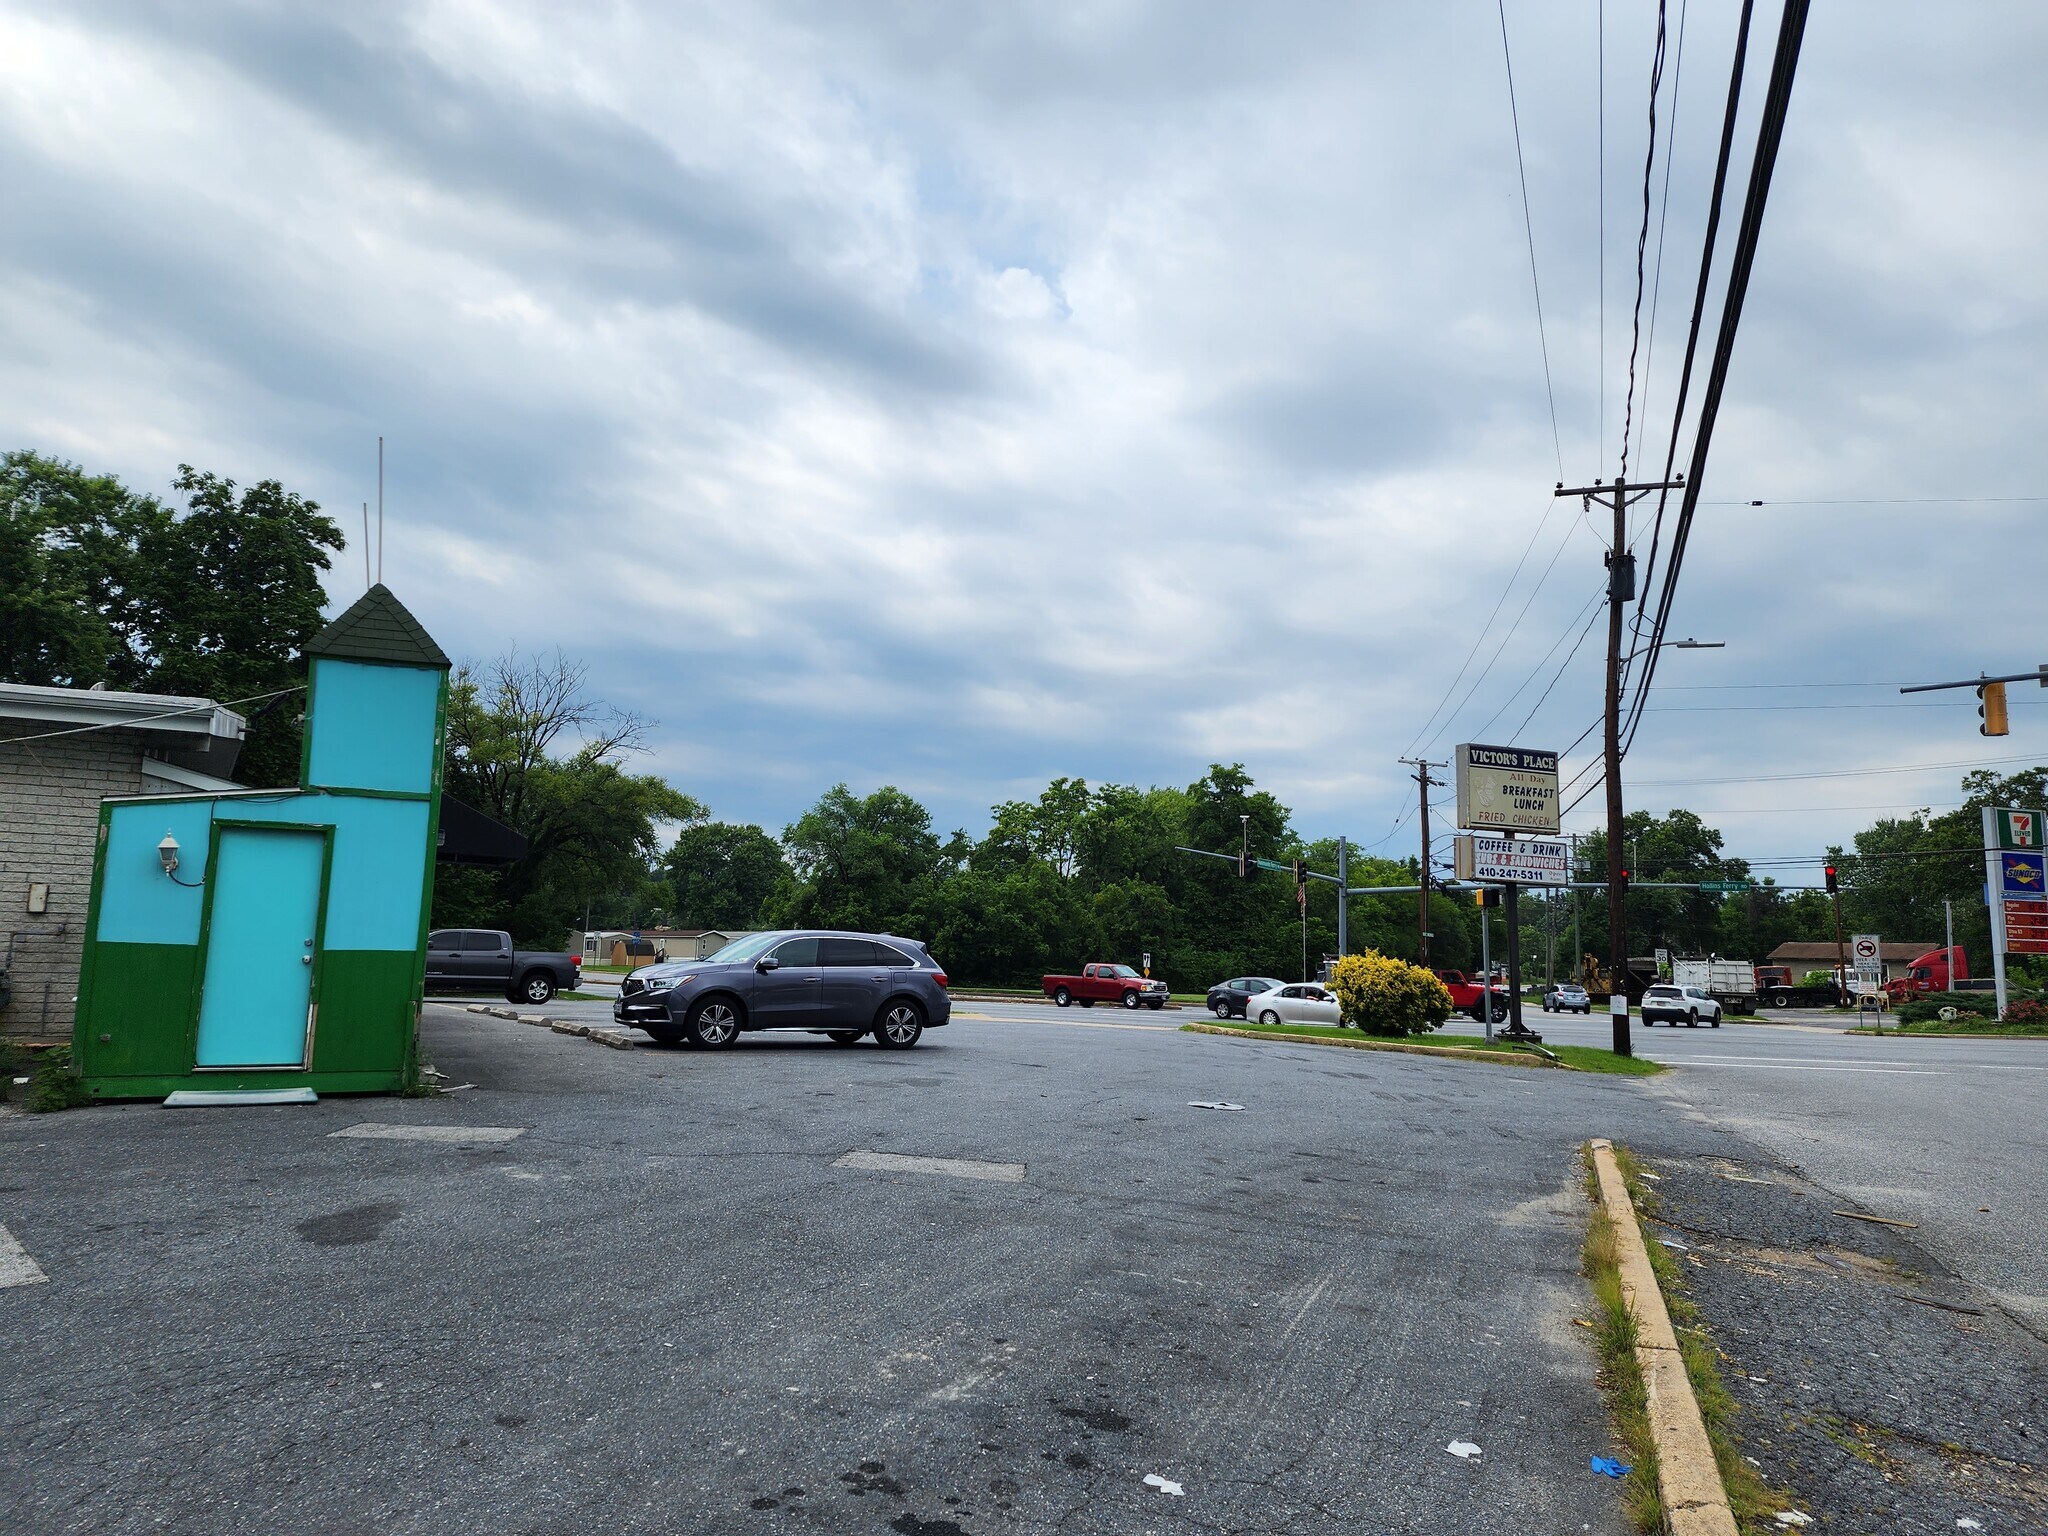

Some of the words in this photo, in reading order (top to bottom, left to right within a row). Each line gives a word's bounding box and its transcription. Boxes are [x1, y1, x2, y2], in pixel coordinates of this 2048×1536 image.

[1471, 749, 1518, 766] VICTOR'S
[1523, 754, 1555, 770] PLACE
[1510, 773, 1524, 782] All
[1530, 775, 1546, 785] Day
[1502, 784, 1554, 799] BREAKFAST
[1514, 798, 1545, 811] LUNCH
[1479, 811, 1506, 823] FRIED
[1512, 814, 1550, 826] CHICKEN
[2013, 816, 2030, 846] 7
[1479, 839, 1513, 853] COFFEE
[1520, 843, 1526, 854] &
[1532, 843, 1561, 858] DRINK
[1475, 852, 1498, 865] SUBS
[1500, 854, 1507, 865] &
[1510, 854, 1566, 870] SANDWICHES
[1479, 867, 1543, 880] 410-247-5311
[2007, 869, 2042, 880] SUNOCO
[1702, 882, 1721, 890] Hollins
[1722, 882, 1739, 890] Ferry
